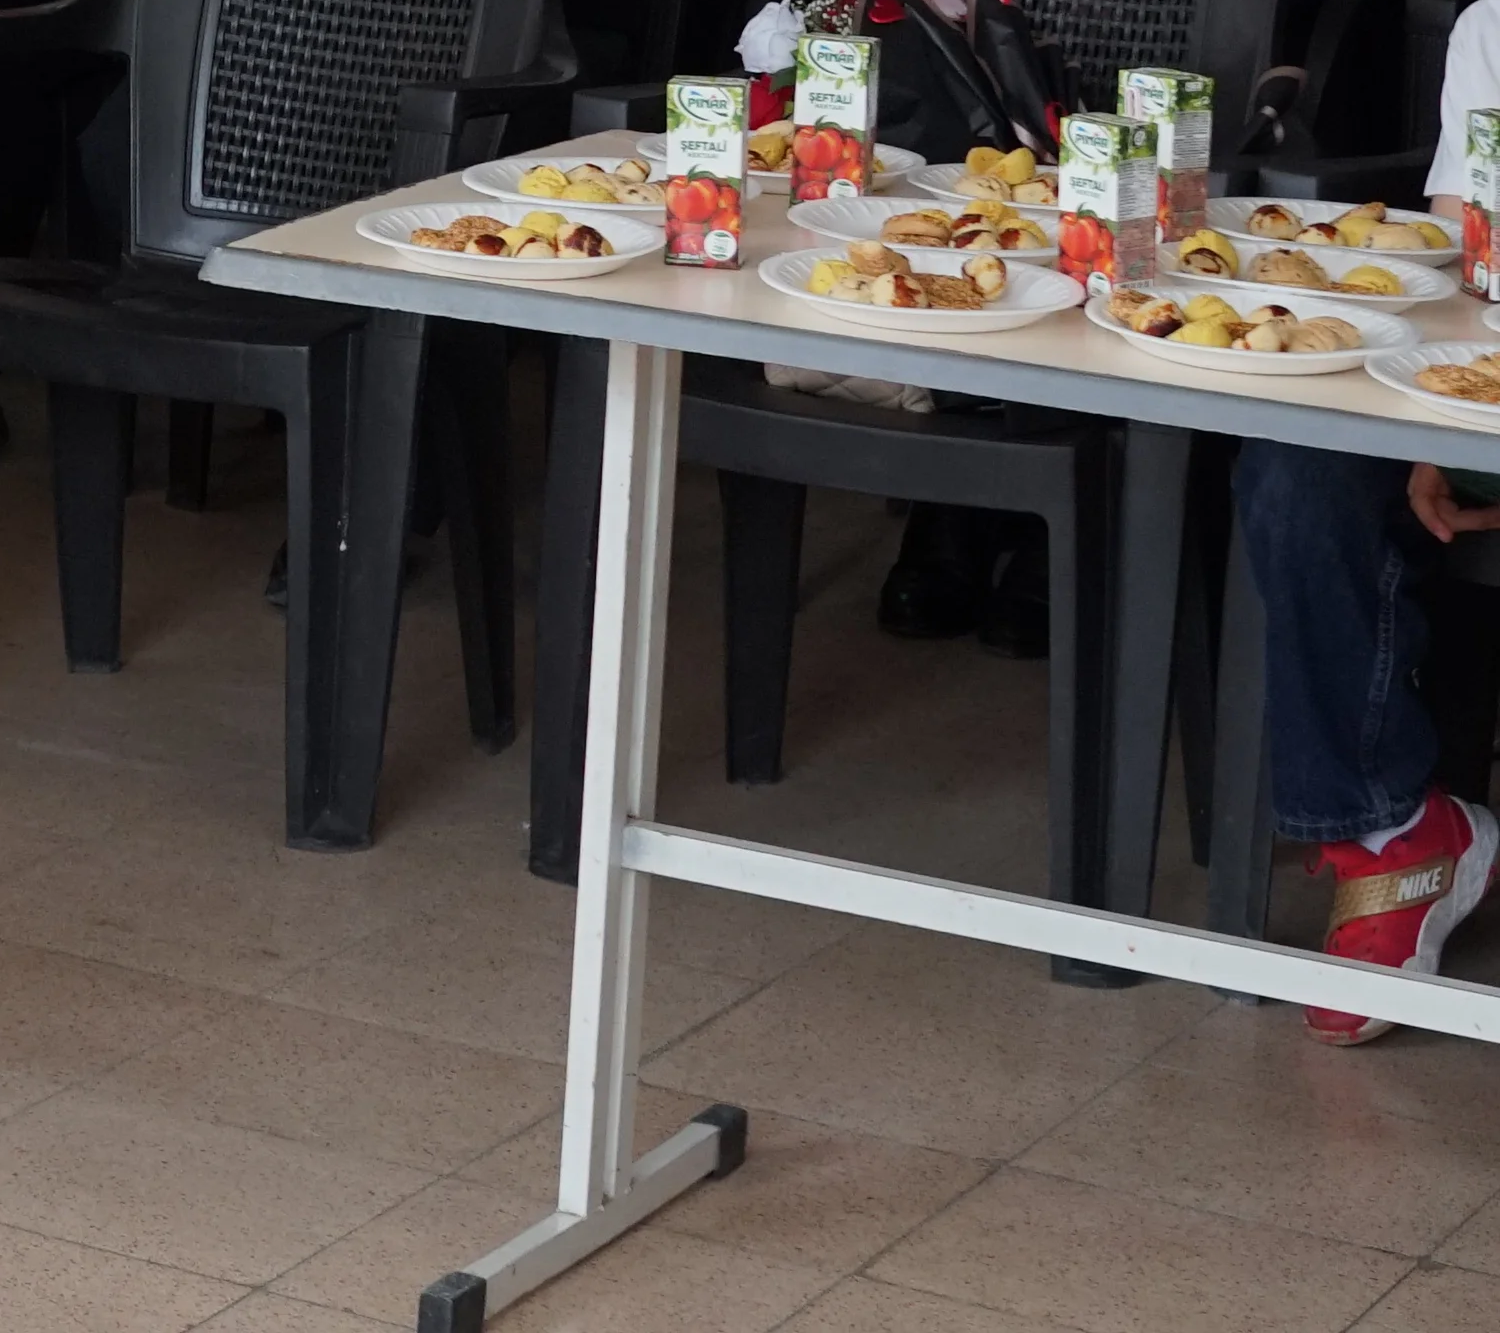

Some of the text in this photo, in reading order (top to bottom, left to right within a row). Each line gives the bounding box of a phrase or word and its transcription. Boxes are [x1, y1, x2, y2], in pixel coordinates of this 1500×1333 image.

[817, 51, 855, 64] PINAR
[687, 97, 728, 110] PINAR
[808, 92, 853, 105] ŞEFTALİ
[680, 139, 728, 153] ŞEFTALİ
[1397, 866, 1443, 902] NIKE
